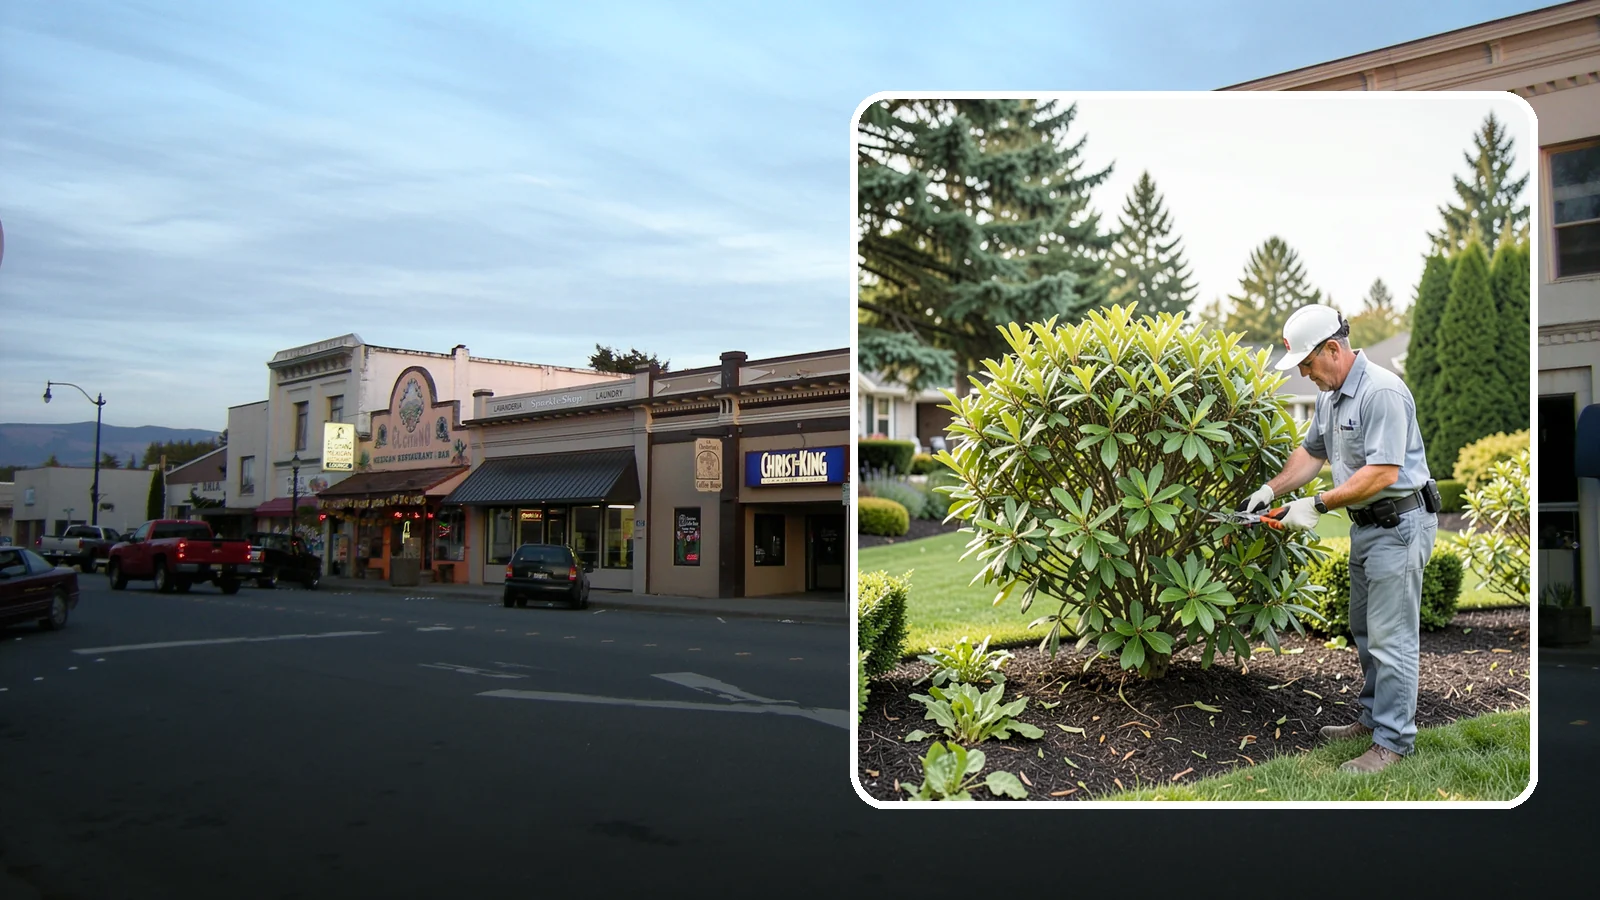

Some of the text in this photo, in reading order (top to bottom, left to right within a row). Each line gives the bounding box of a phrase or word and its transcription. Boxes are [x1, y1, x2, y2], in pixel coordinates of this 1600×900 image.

[595, 389, 623, 399] LAUNDRY
[494, 402, 522, 412] LAVANDERIA
[531, 395, 583, 408] Sparkle Shop
[374, 456, 396, 464] MEXICAN
[398, 451, 433, 463] RESTAURANT
[438, 450, 450, 459] BAR
[799, 450, 827, 476] KING
